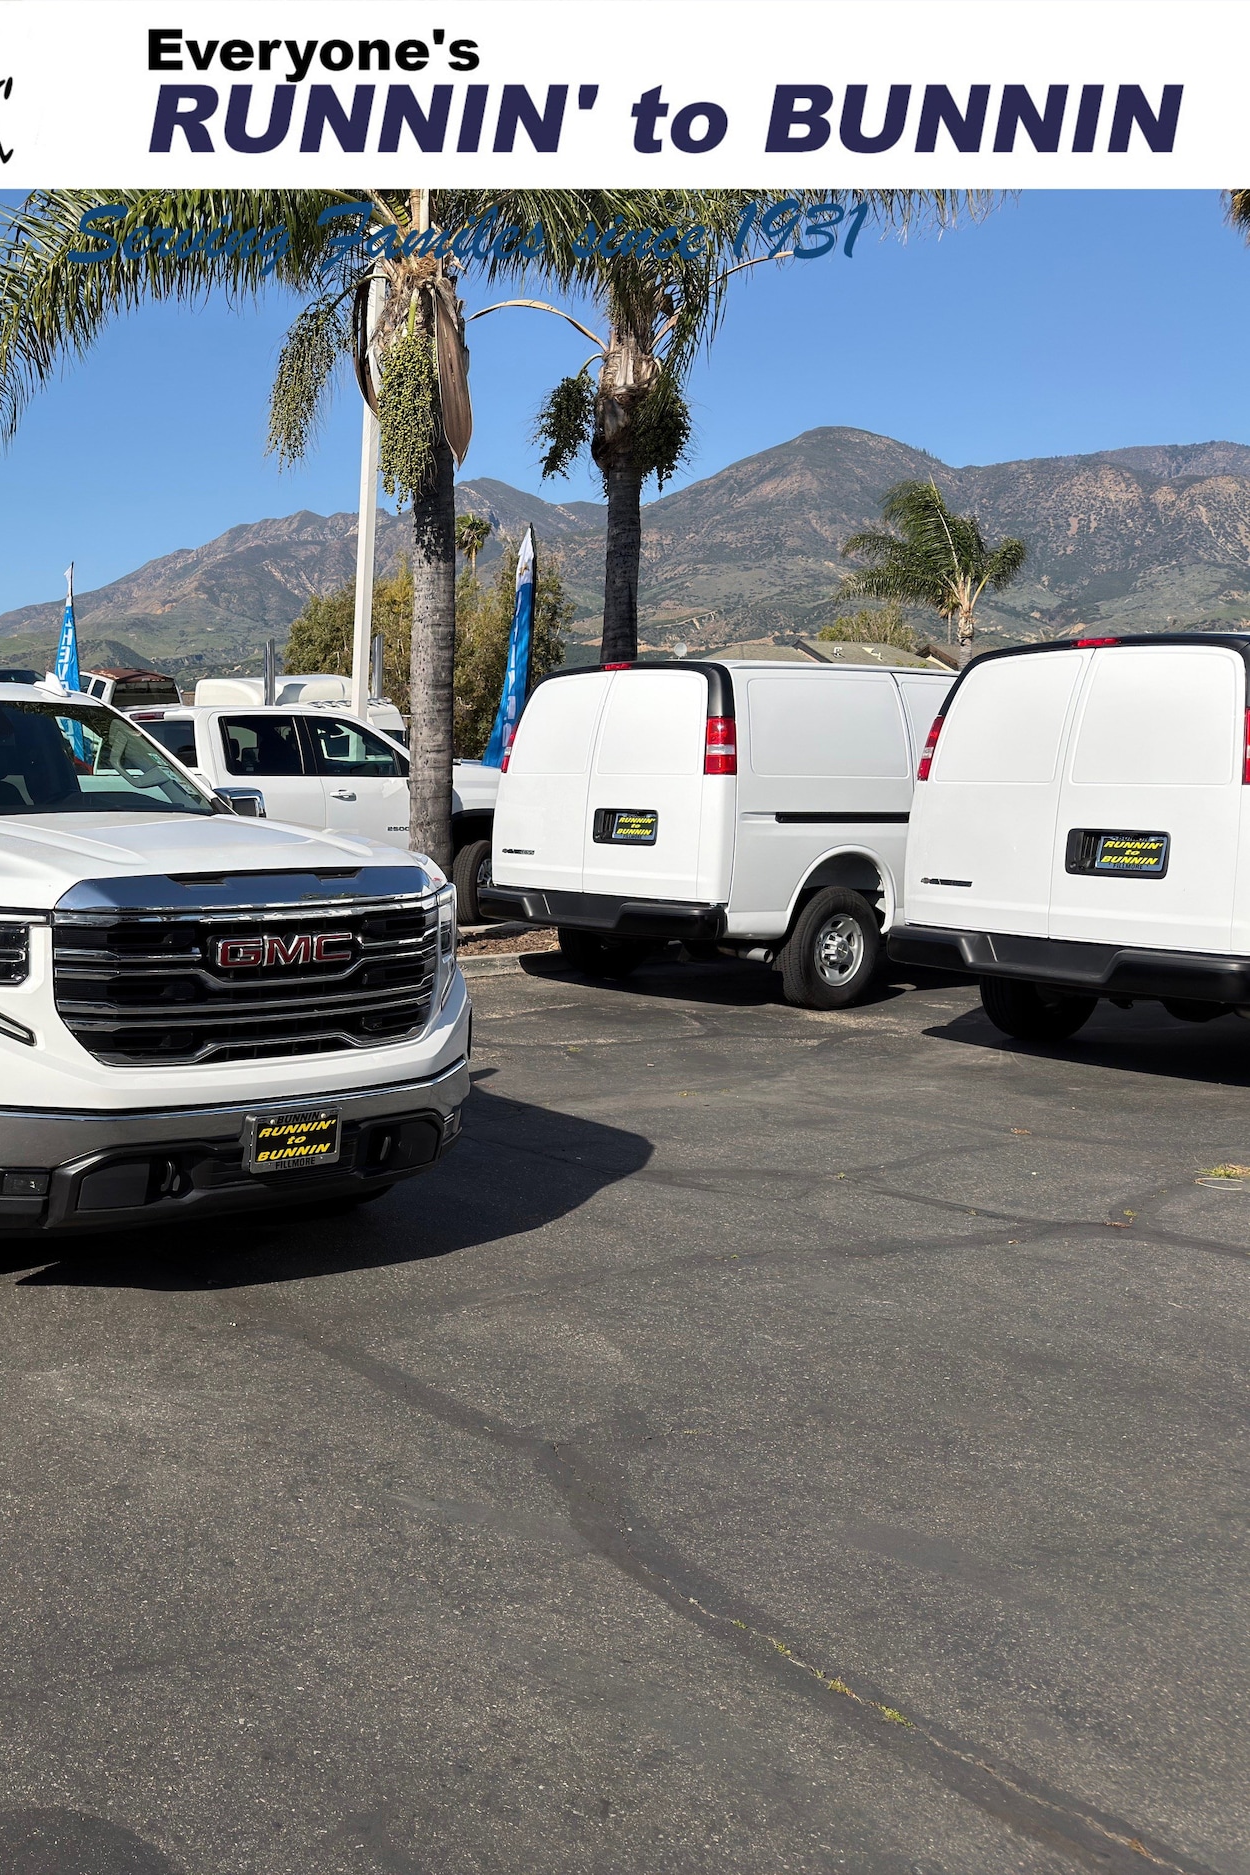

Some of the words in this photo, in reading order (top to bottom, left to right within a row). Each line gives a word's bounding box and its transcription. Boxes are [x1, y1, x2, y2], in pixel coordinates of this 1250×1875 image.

[616, 828, 653, 836] BUNNIN
[1104, 841, 1163, 849] RUNNIN'
[1101, 856, 1158, 865] BUNNIN
[217, 932, 353, 968] GMC
[277, 1111, 320, 1124] BUNNIN
[258, 1119, 337, 1139] RUNNIN'
[286, 1135, 307, 1145] to
[257, 1142, 332, 1162] BUNNIN
[275, 1156, 316, 1170] FILLMORE
